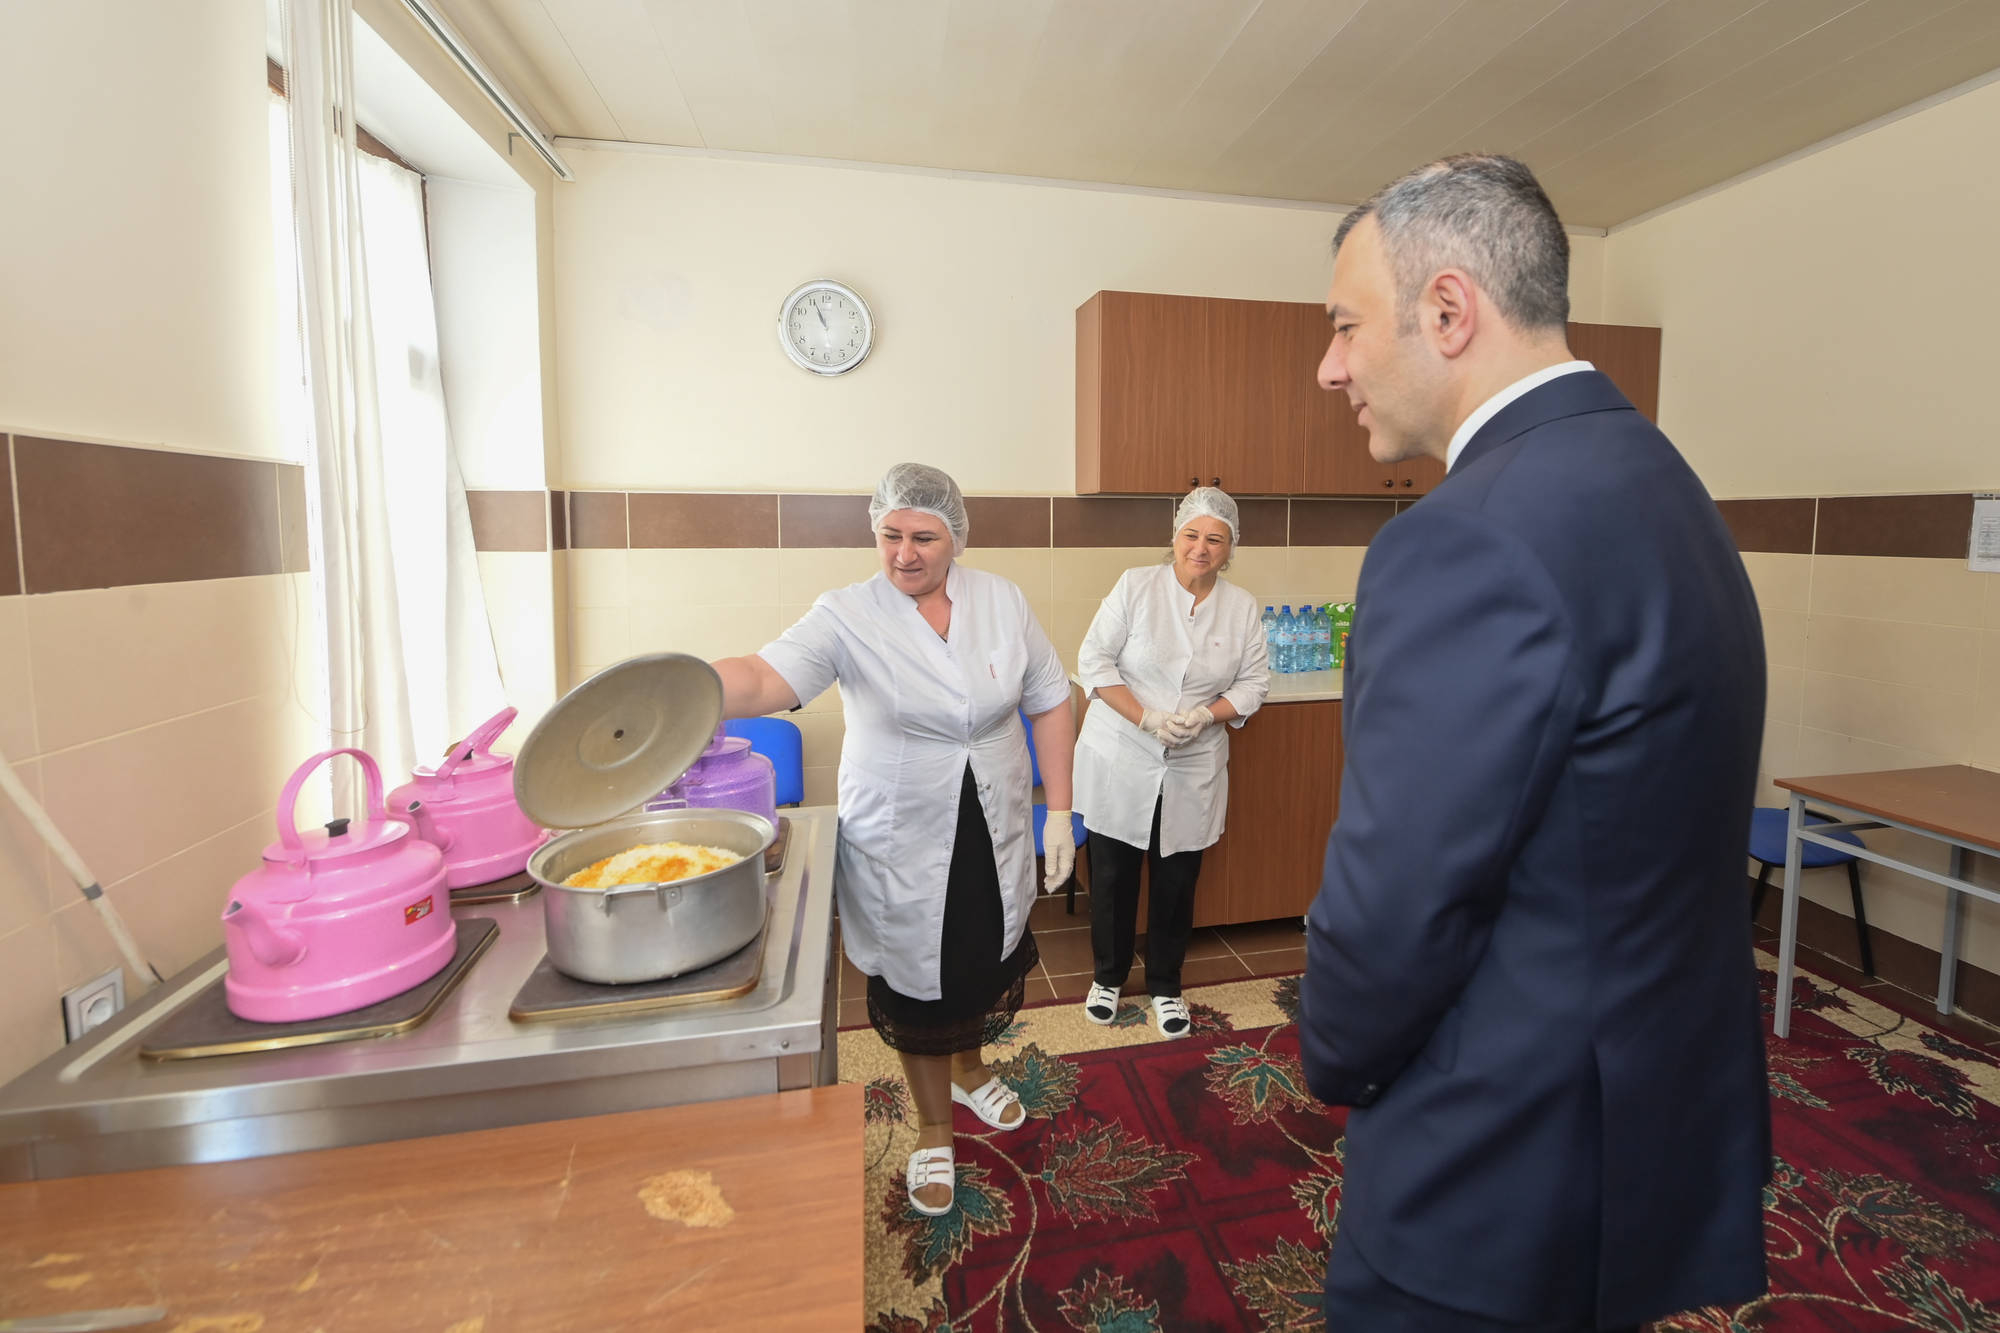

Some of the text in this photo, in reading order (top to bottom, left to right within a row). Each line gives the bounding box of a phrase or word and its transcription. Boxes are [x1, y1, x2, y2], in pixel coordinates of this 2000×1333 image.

[808, 298, 816, 306] 11
[822, 295, 832, 303] 12
[848, 311, 856, 319] 2
[794, 322, 802, 330] 9
[799, 336, 806, 344] 8
[847, 339, 854, 347] 4
[810, 347, 816, 355] 7
[839, 349, 846, 357] 5
[823, 352, 830, 361] 6
